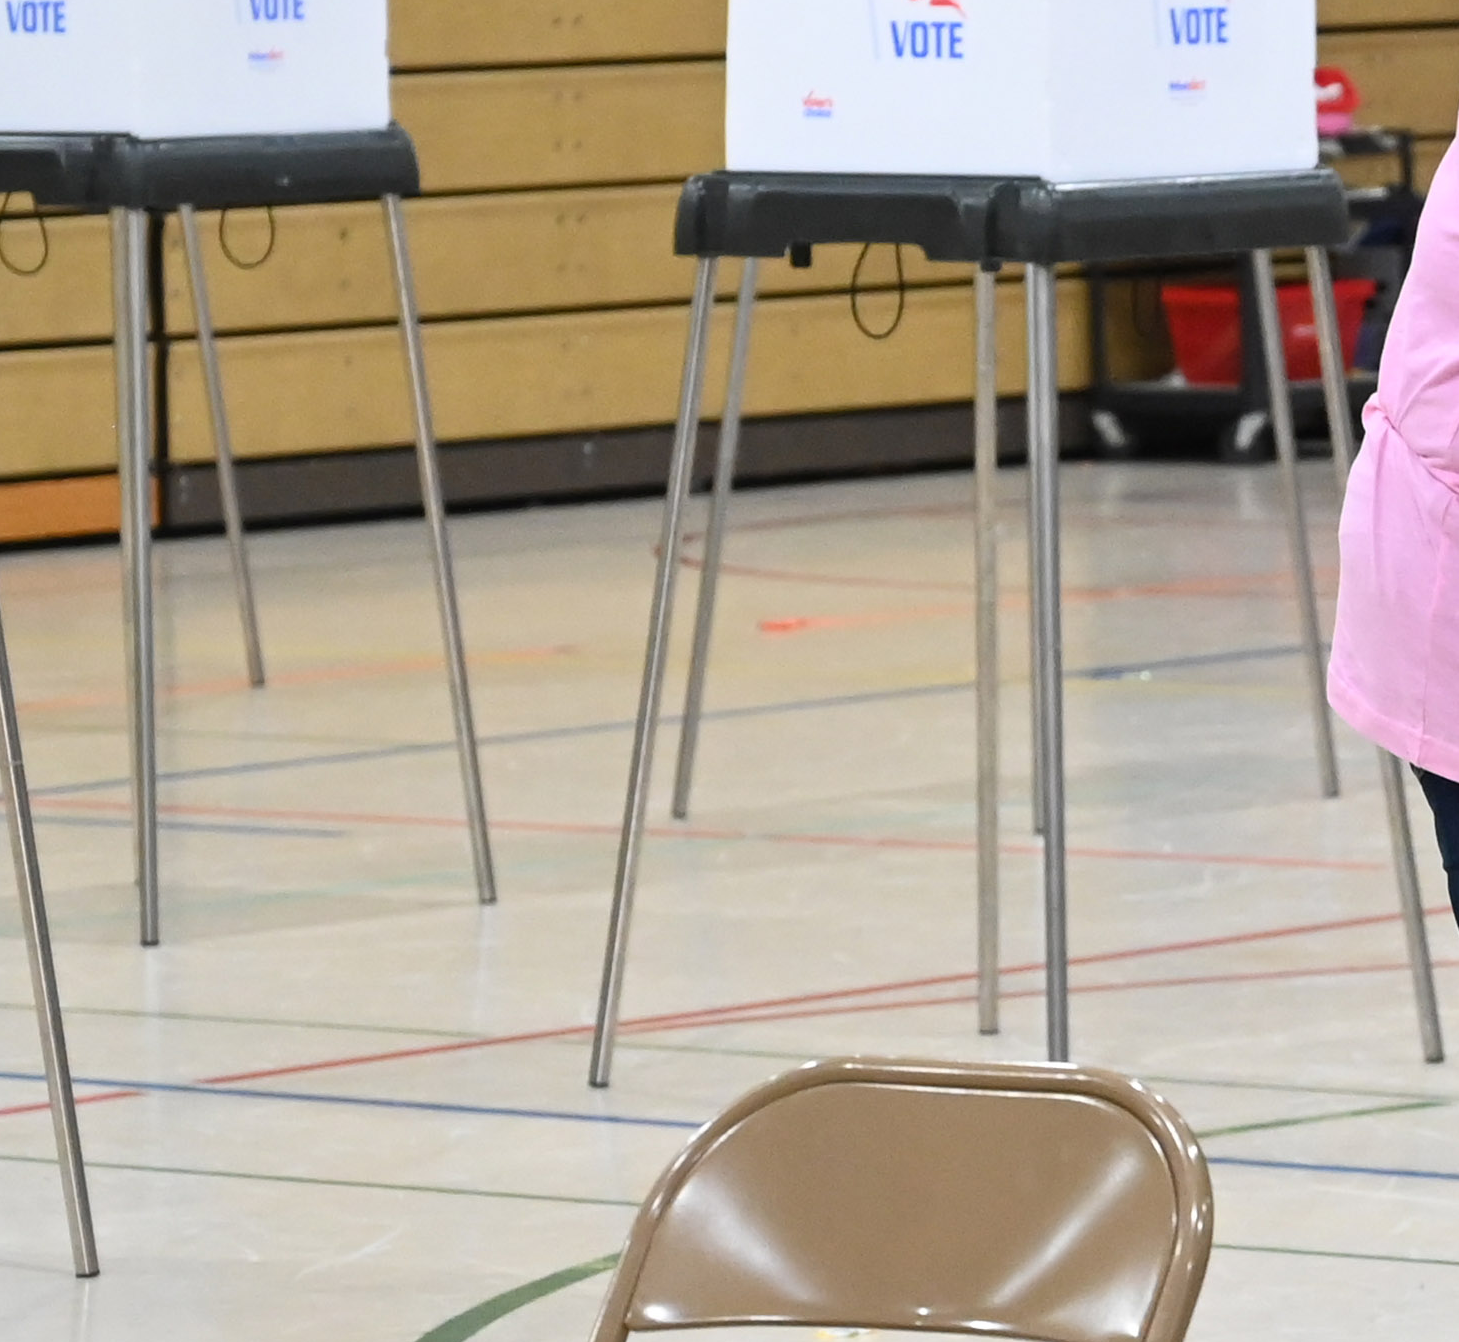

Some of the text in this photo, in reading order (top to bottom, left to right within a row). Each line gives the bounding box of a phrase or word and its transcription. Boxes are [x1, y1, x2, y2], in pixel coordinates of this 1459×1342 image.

[5, 0, 67, 34] VOTE
[1169, 6, 1229, 45] VOTE
[890, 20, 964, 59] VOTE
